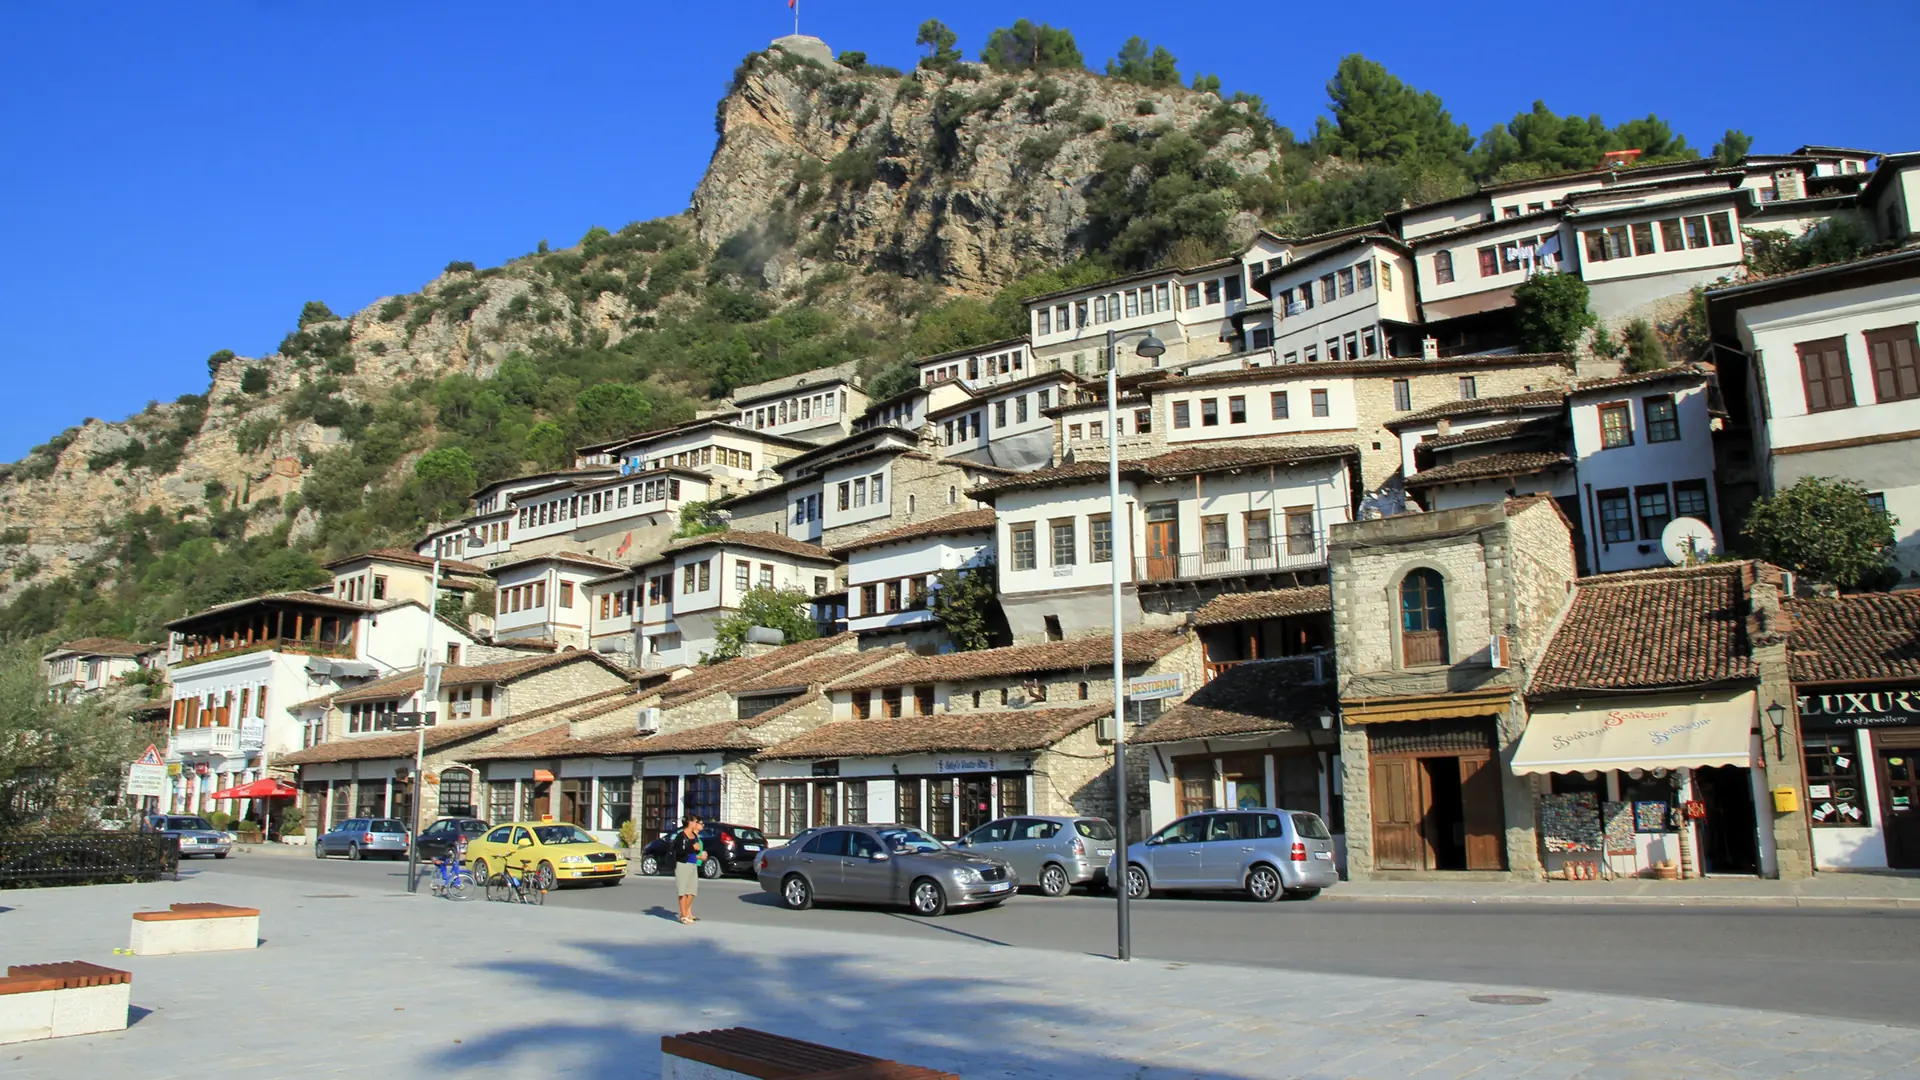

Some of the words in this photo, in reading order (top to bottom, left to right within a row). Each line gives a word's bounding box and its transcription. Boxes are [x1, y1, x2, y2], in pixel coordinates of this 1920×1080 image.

[1131, 678, 1180, 695] RESTORANT
[1797, 691, 1920, 716] LUXUR
[1604, 711, 1668, 726] Souvenir
[1853, 717, 1863, 725] of
[1863, 715, 1908, 725] Jewellery
[1552, 726, 1611, 751] Souvenir
[1649, 718, 1711, 745] Souvenir
